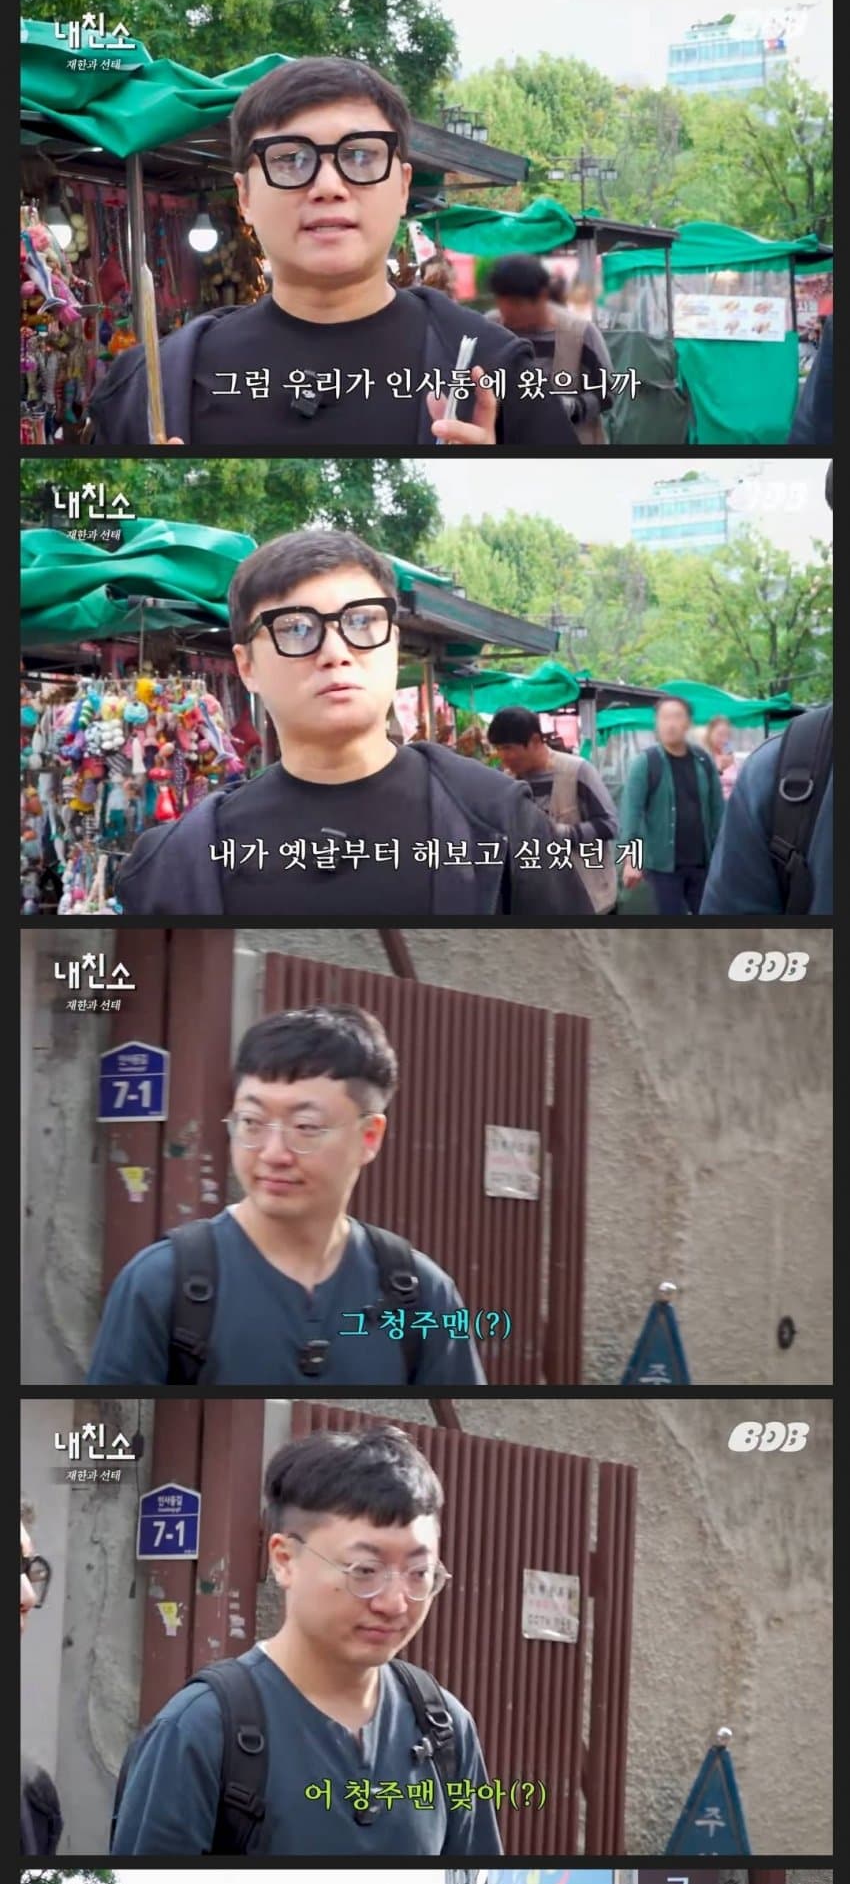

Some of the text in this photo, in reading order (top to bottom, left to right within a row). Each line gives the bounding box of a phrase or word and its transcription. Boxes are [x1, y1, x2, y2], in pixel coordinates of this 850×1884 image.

[112, 1080, 152, 1109] 7-1
[152, 1520, 185, 1547] 7-1
[694, 1806, 726, 1838] 주
